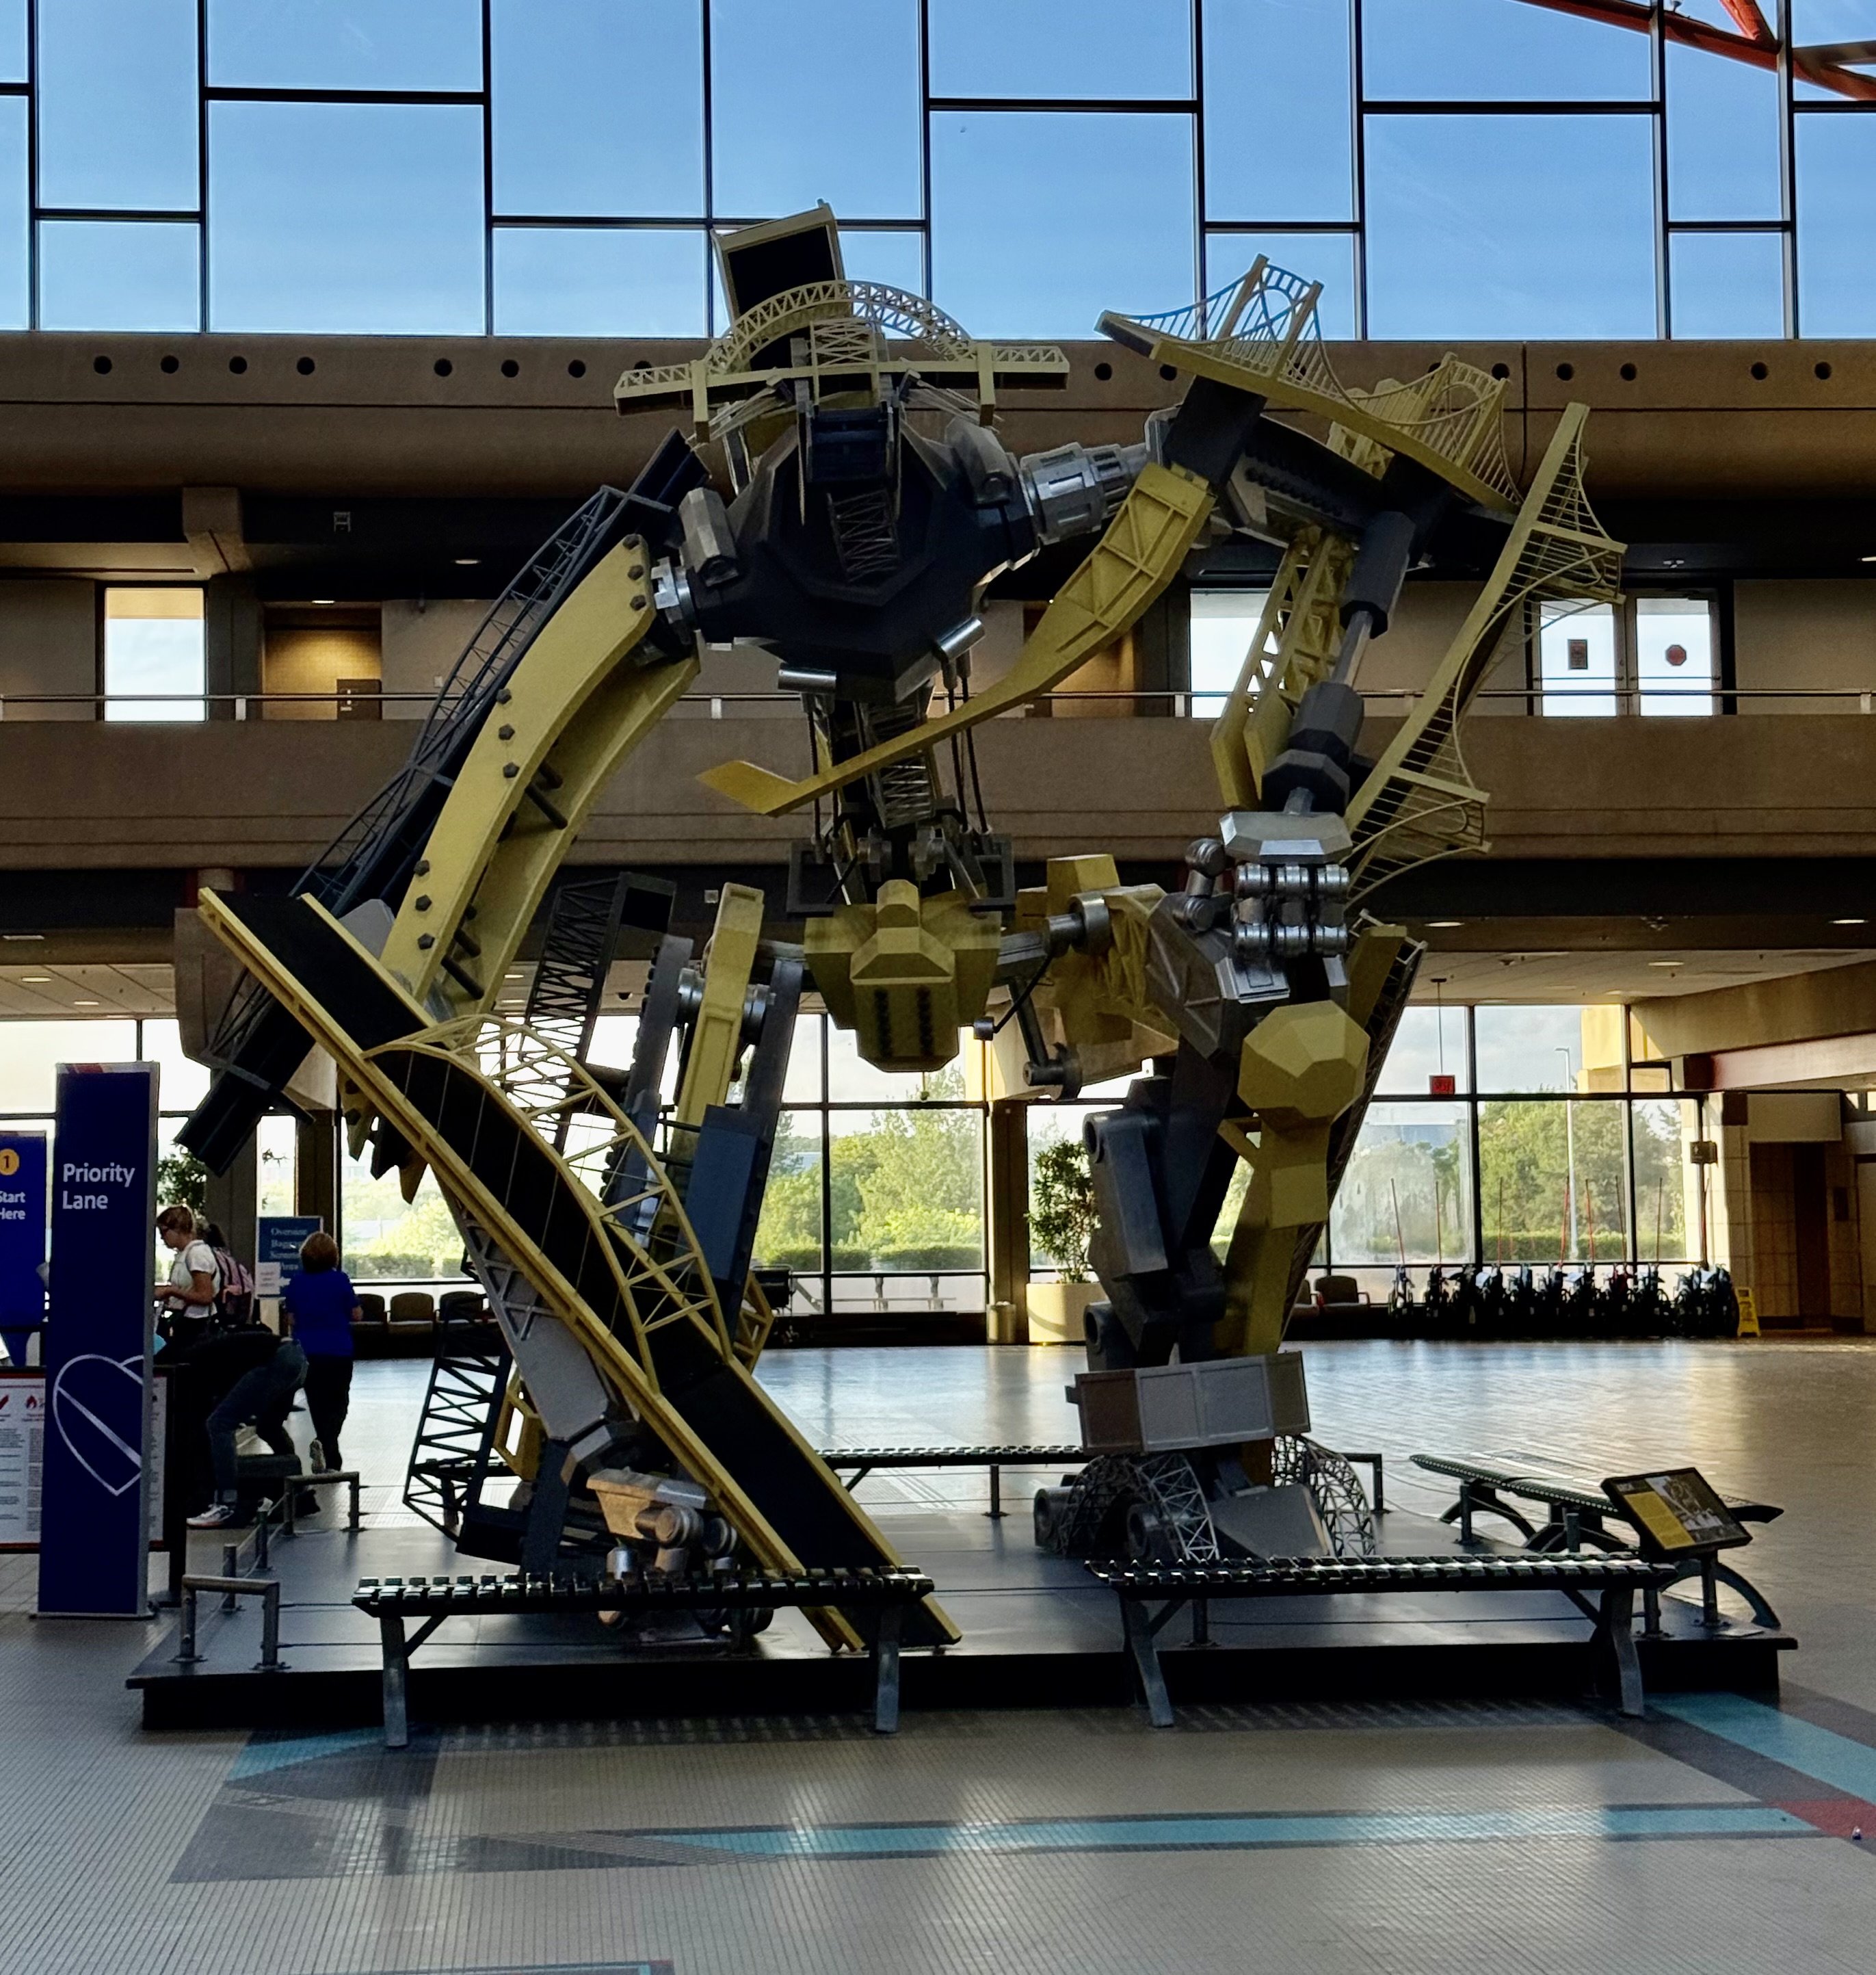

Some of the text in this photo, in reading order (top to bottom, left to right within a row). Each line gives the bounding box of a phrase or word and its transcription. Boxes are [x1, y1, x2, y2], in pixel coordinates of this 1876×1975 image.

[3, 1155, 10, 1168] 1
[63, 1162, 135, 1188] Priority
[62, 1190, 108, 1209] Lane
